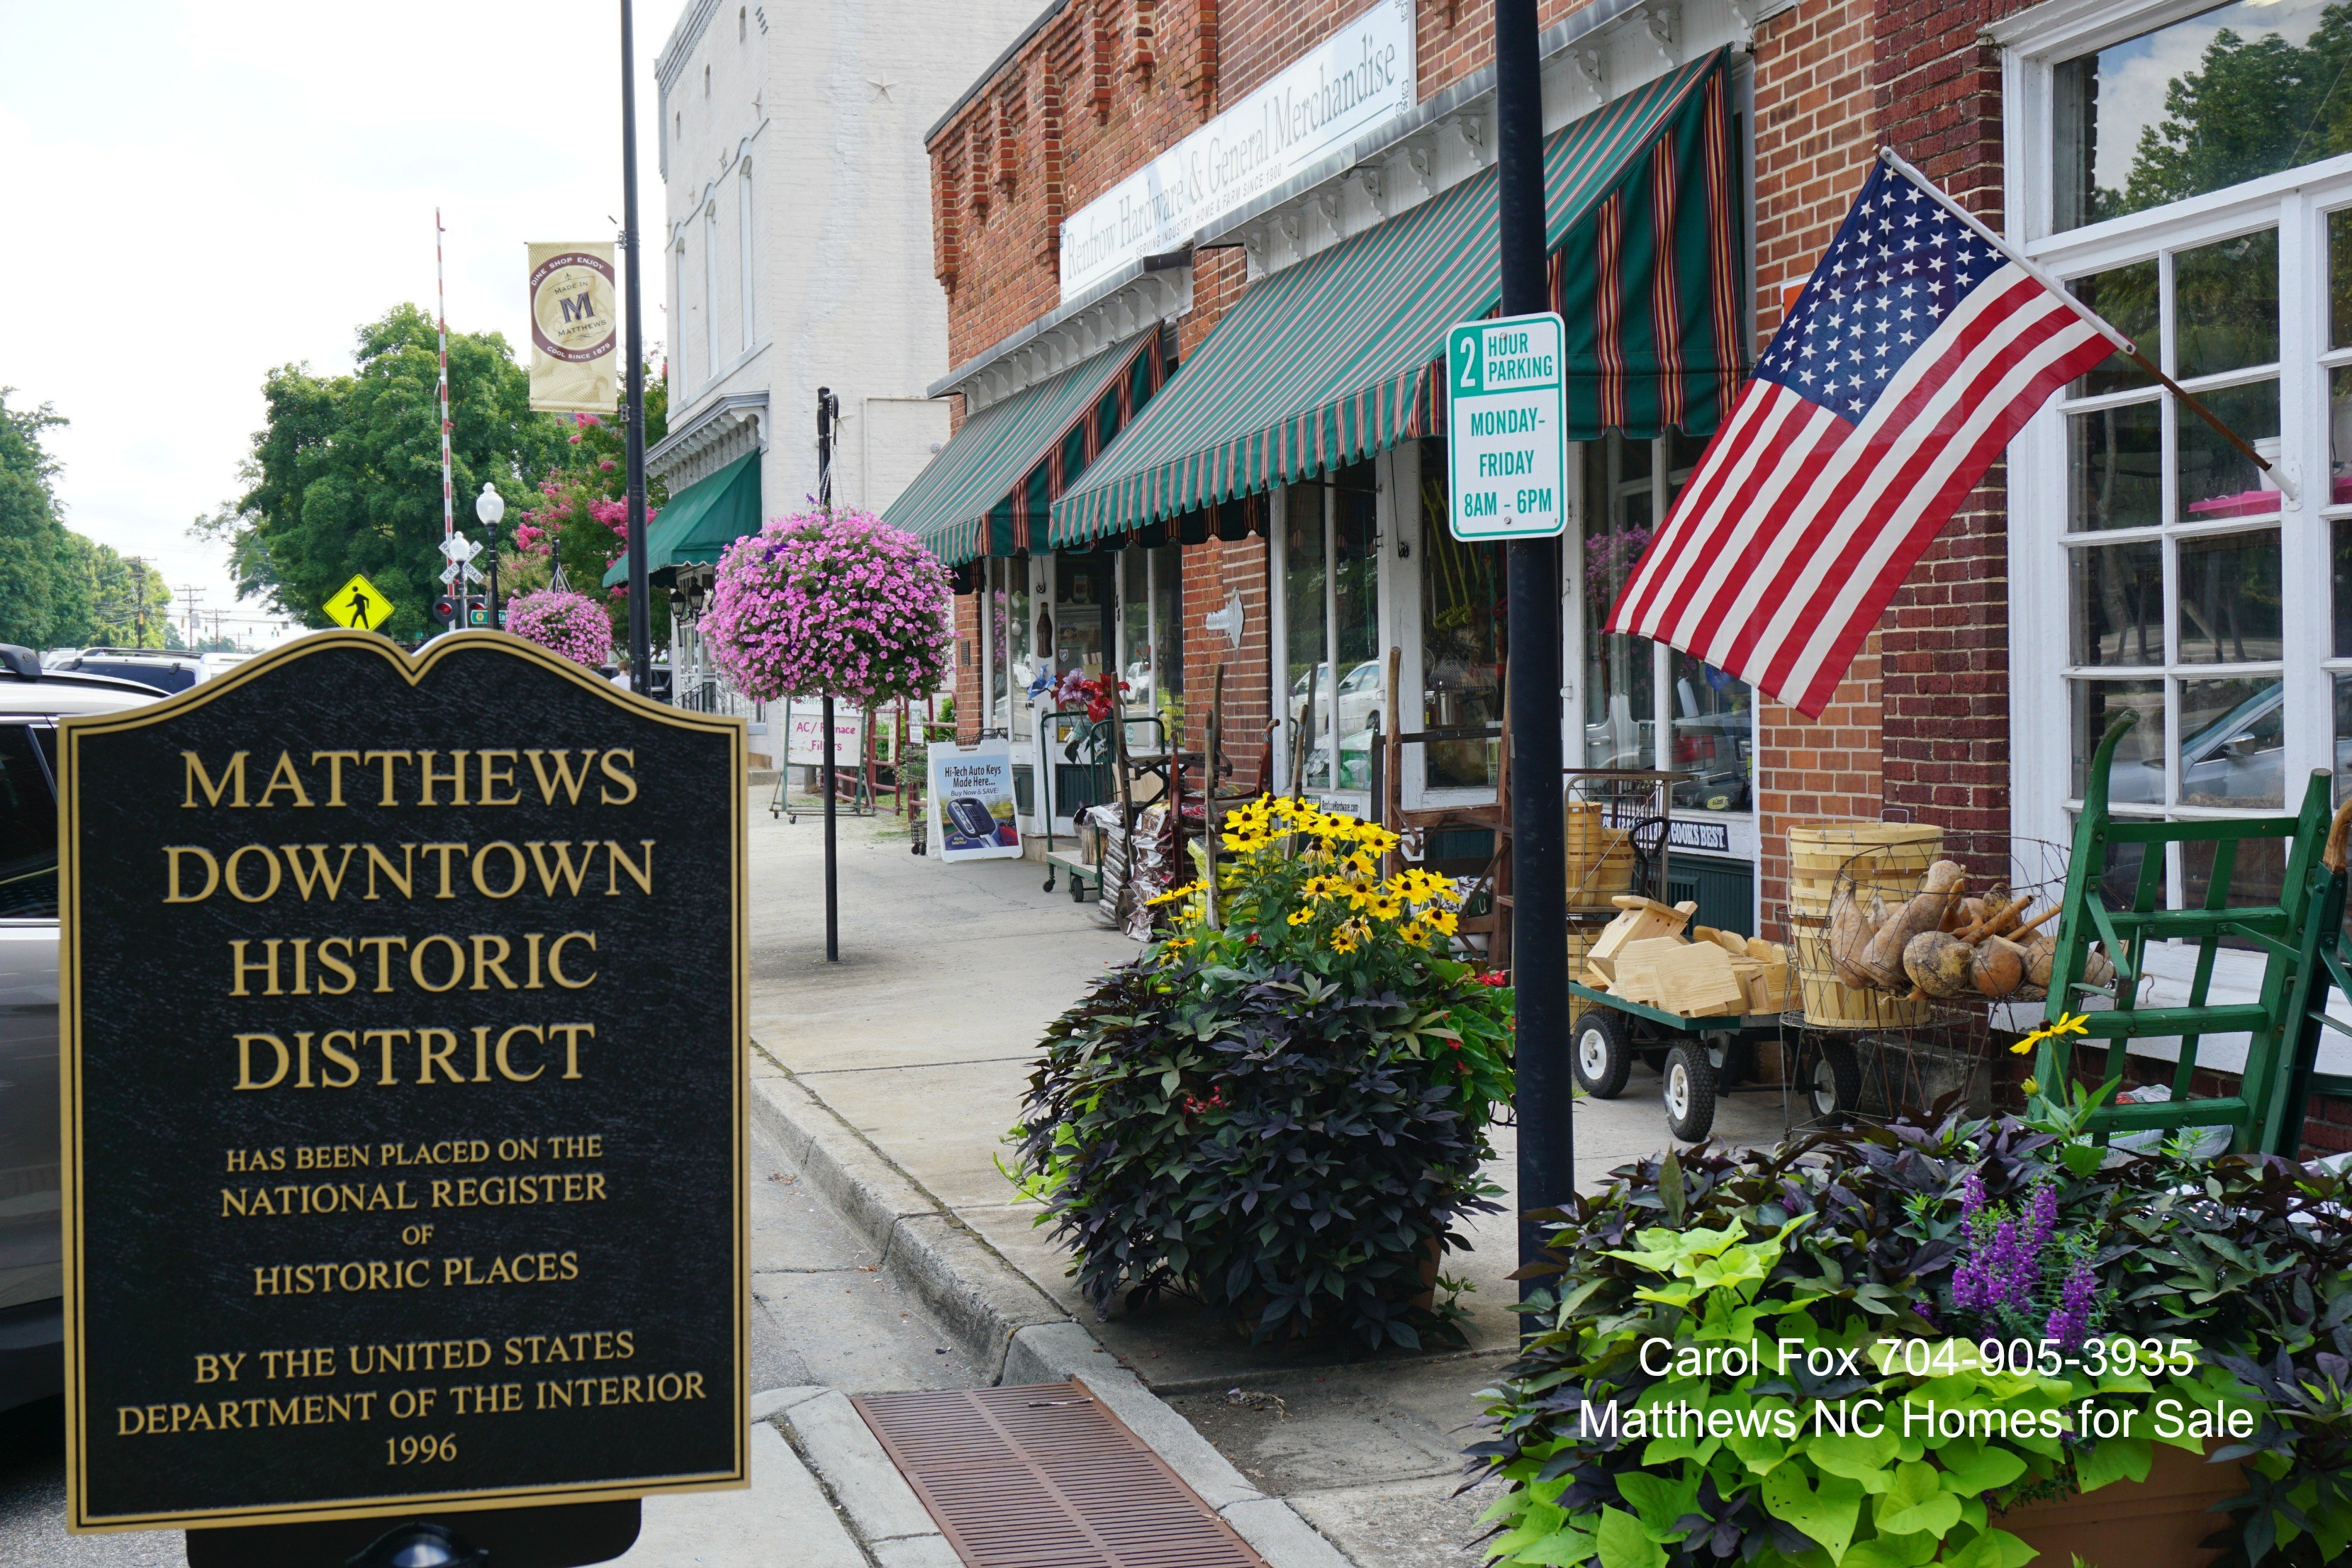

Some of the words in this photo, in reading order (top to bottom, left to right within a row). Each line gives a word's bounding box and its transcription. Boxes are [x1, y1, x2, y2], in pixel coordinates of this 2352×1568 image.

[1067, 215, 1116, 280] Renfrow
[1119, 178, 1183, 248] Hardware
[1189, 150, 1204, 205] &
[1209, 99, 1269, 194] General
[1275, 33, 1394, 155] Merchandise
[1136, 237, 1160, 259] SERVING
[1162, 215, 1193, 245] INDUSTRY,
[1196, 202, 1214, 224] HOME
[1216, 199, 1221, 212] &
[1223, 188, 1241, 208] FARM
[1243, 174, 1263, 196] SINCE
[1267, 163, 1282, 184] 1900
[531, 268, 547, 286] DINE
[549, 257, 572, 269] SHOP
[577, 257, 603, 269] ENJOY
[554, 283, 577, 295] MADE
[558, 291, 595, 324] M
[558, 320, 607, 337] MATTHEWS
[547, 346, 566, 357] COOL
[593, 343, 610, 355] 1879
[1489, 332, 1528, 357] HOUR
[1460, 336, 1476, 388] 2
[1489, 355, 1552, 382] PARKING
[1471, 407, 1545, 437] MONDAY-
[1479, 449, 1534, 478] FRIDAY
[1465, 491, 1497, 517] 8AM
[1517, 488, 1552, 514] 6PM
[464, 564, 481, 581] ROAD
[181, 749, 638, 807] MATTHEWS
[945, 766, 967, 778] Hi-Tech
[969, 766, 985, 777] Auto
[986, 764, 1001, 777] Keys
[953, 777, 972, 788] Made
[973, 776, 995, 787] Here...
[1671, 822, 1700, 846] COOKS
[1699, 825, 1726, 849] BEST.
[162, 841, 655, 903] DOWNTOWN
[229, 933, 598, 996] HISTORIC
[233, 1024, 595, 1090] DISTRICT
[227, 1149, 286, 1172] HAS
[296, 1146, 370, 1169] BEEN
[381, 1141, 491, 1165] PLACED
[498, 1138, 538, 1161] ON
[547, 1137, 603, 1158] THE
[221, 1182, 418, 1216] NATIONAL
[432, 1174, 607, 1207] REGISTER
[401, 1226, 434, 1245] OF
[254, 1260, 430, 1295] HISTORIC
[444, 1253, 579, 1286] PLACES
[196, 1353, 246, 1383] BY
[259, 1348, 336, 1379] THE
[349, 1340, 492, 1374] UNITED
[504, 1331, 634, 1365] STATES
[118, 1393, 377, 1435] DEPARTMENT
[388, 1389, 437, 1418] OF
[449, 1384, 523, 1414] THE
[537, 1373, 706, 1409] INTERIOR
[385, 1435, 457, 1465] 1996
